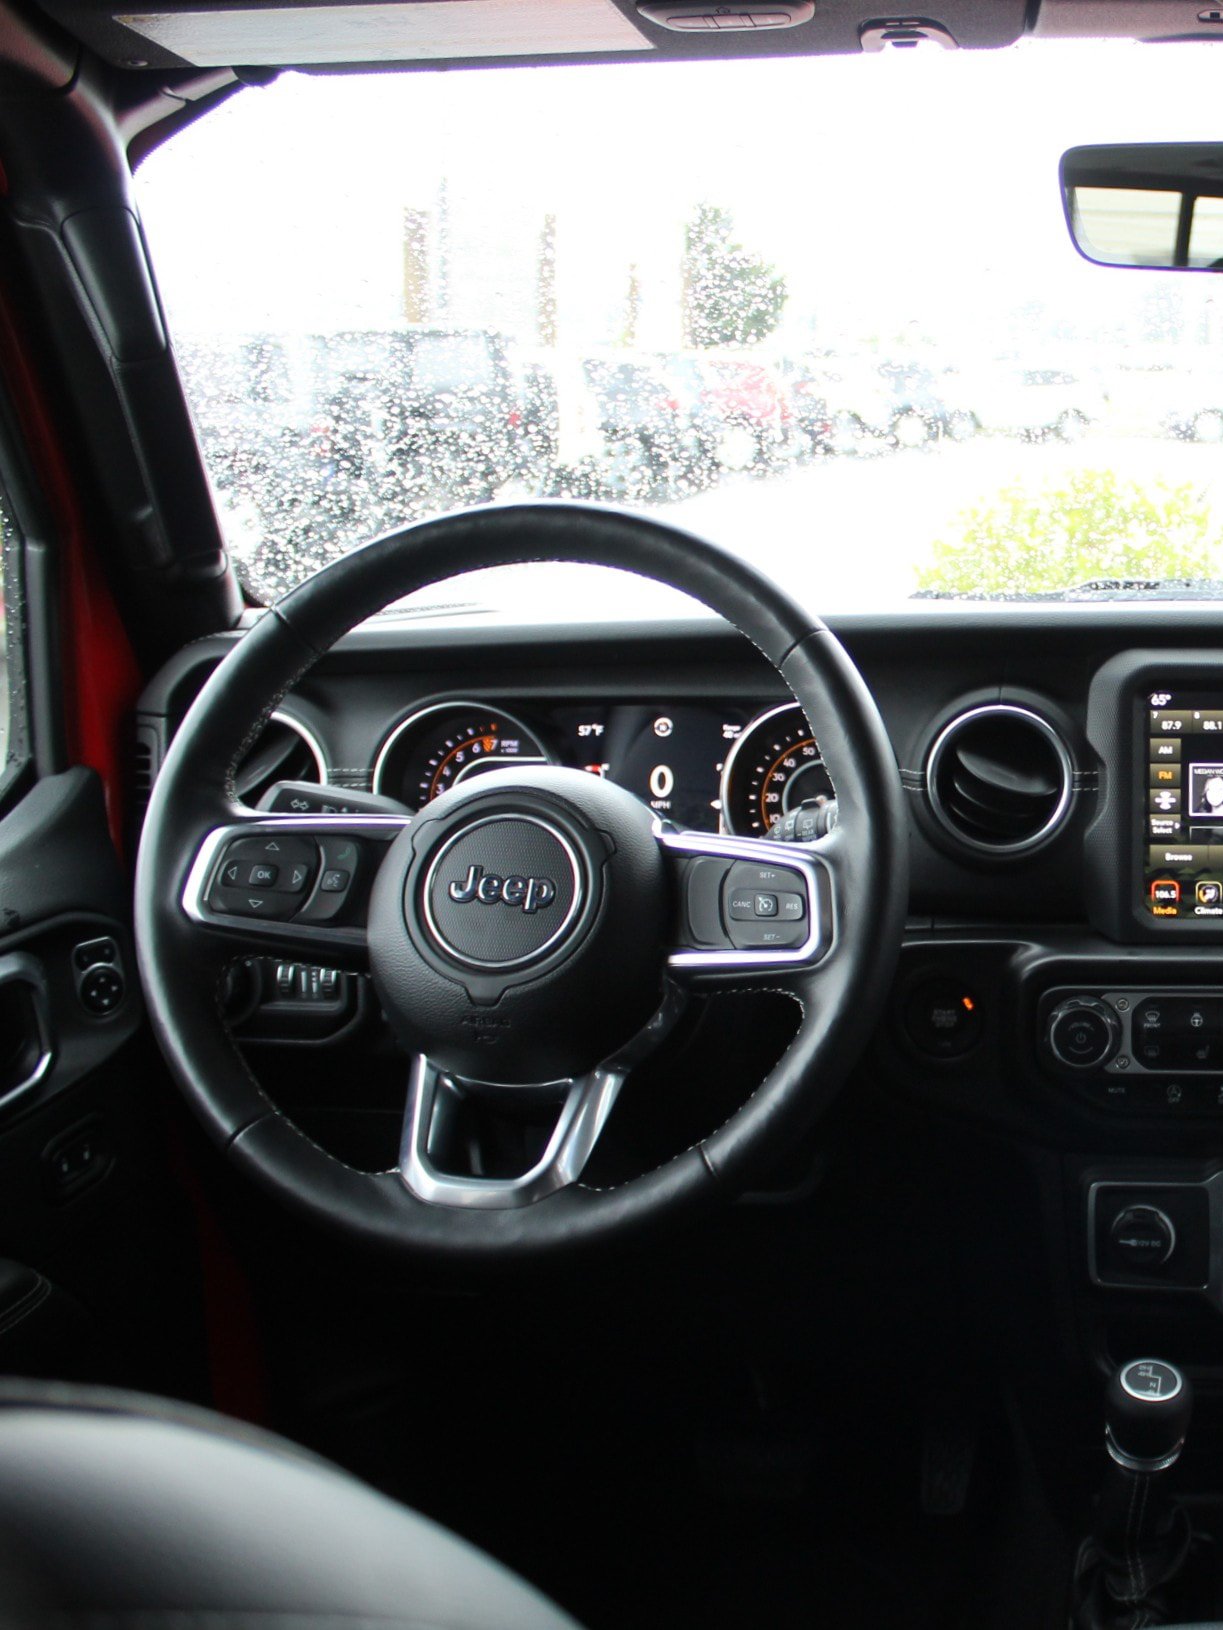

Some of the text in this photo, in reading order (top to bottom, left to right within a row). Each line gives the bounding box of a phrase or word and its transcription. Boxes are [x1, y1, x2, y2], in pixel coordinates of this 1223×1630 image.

[1161, 721, 1182, 730] 87.9
[1203, 721, 1222, 730] 88.1
[472, 743, 480, 753] 6
[490, 739, 498, 751] 7
[1158, 746, 1173, 754] AM
[802, 746, 815, 756] 50
[455, 751, 465, 762] 5
[783, 758, 796, 768] 40
[442, 766, 451, 777] 4
[1158, 771, 1173, 780] FM
[650, 765, 674, 798] 0
[772, 773, 785, 782] 30
[765, 793, 779, 803] 20
[769, 814, 780, 824] 10
[1165, 852, 1193, 861] Browse
[257, 871, 271, 880] OK
[450, 865, 556, 914] Jeep
[1153, 906, 1177, 915] Media
[1194, 906, 1223, 915] Climate
